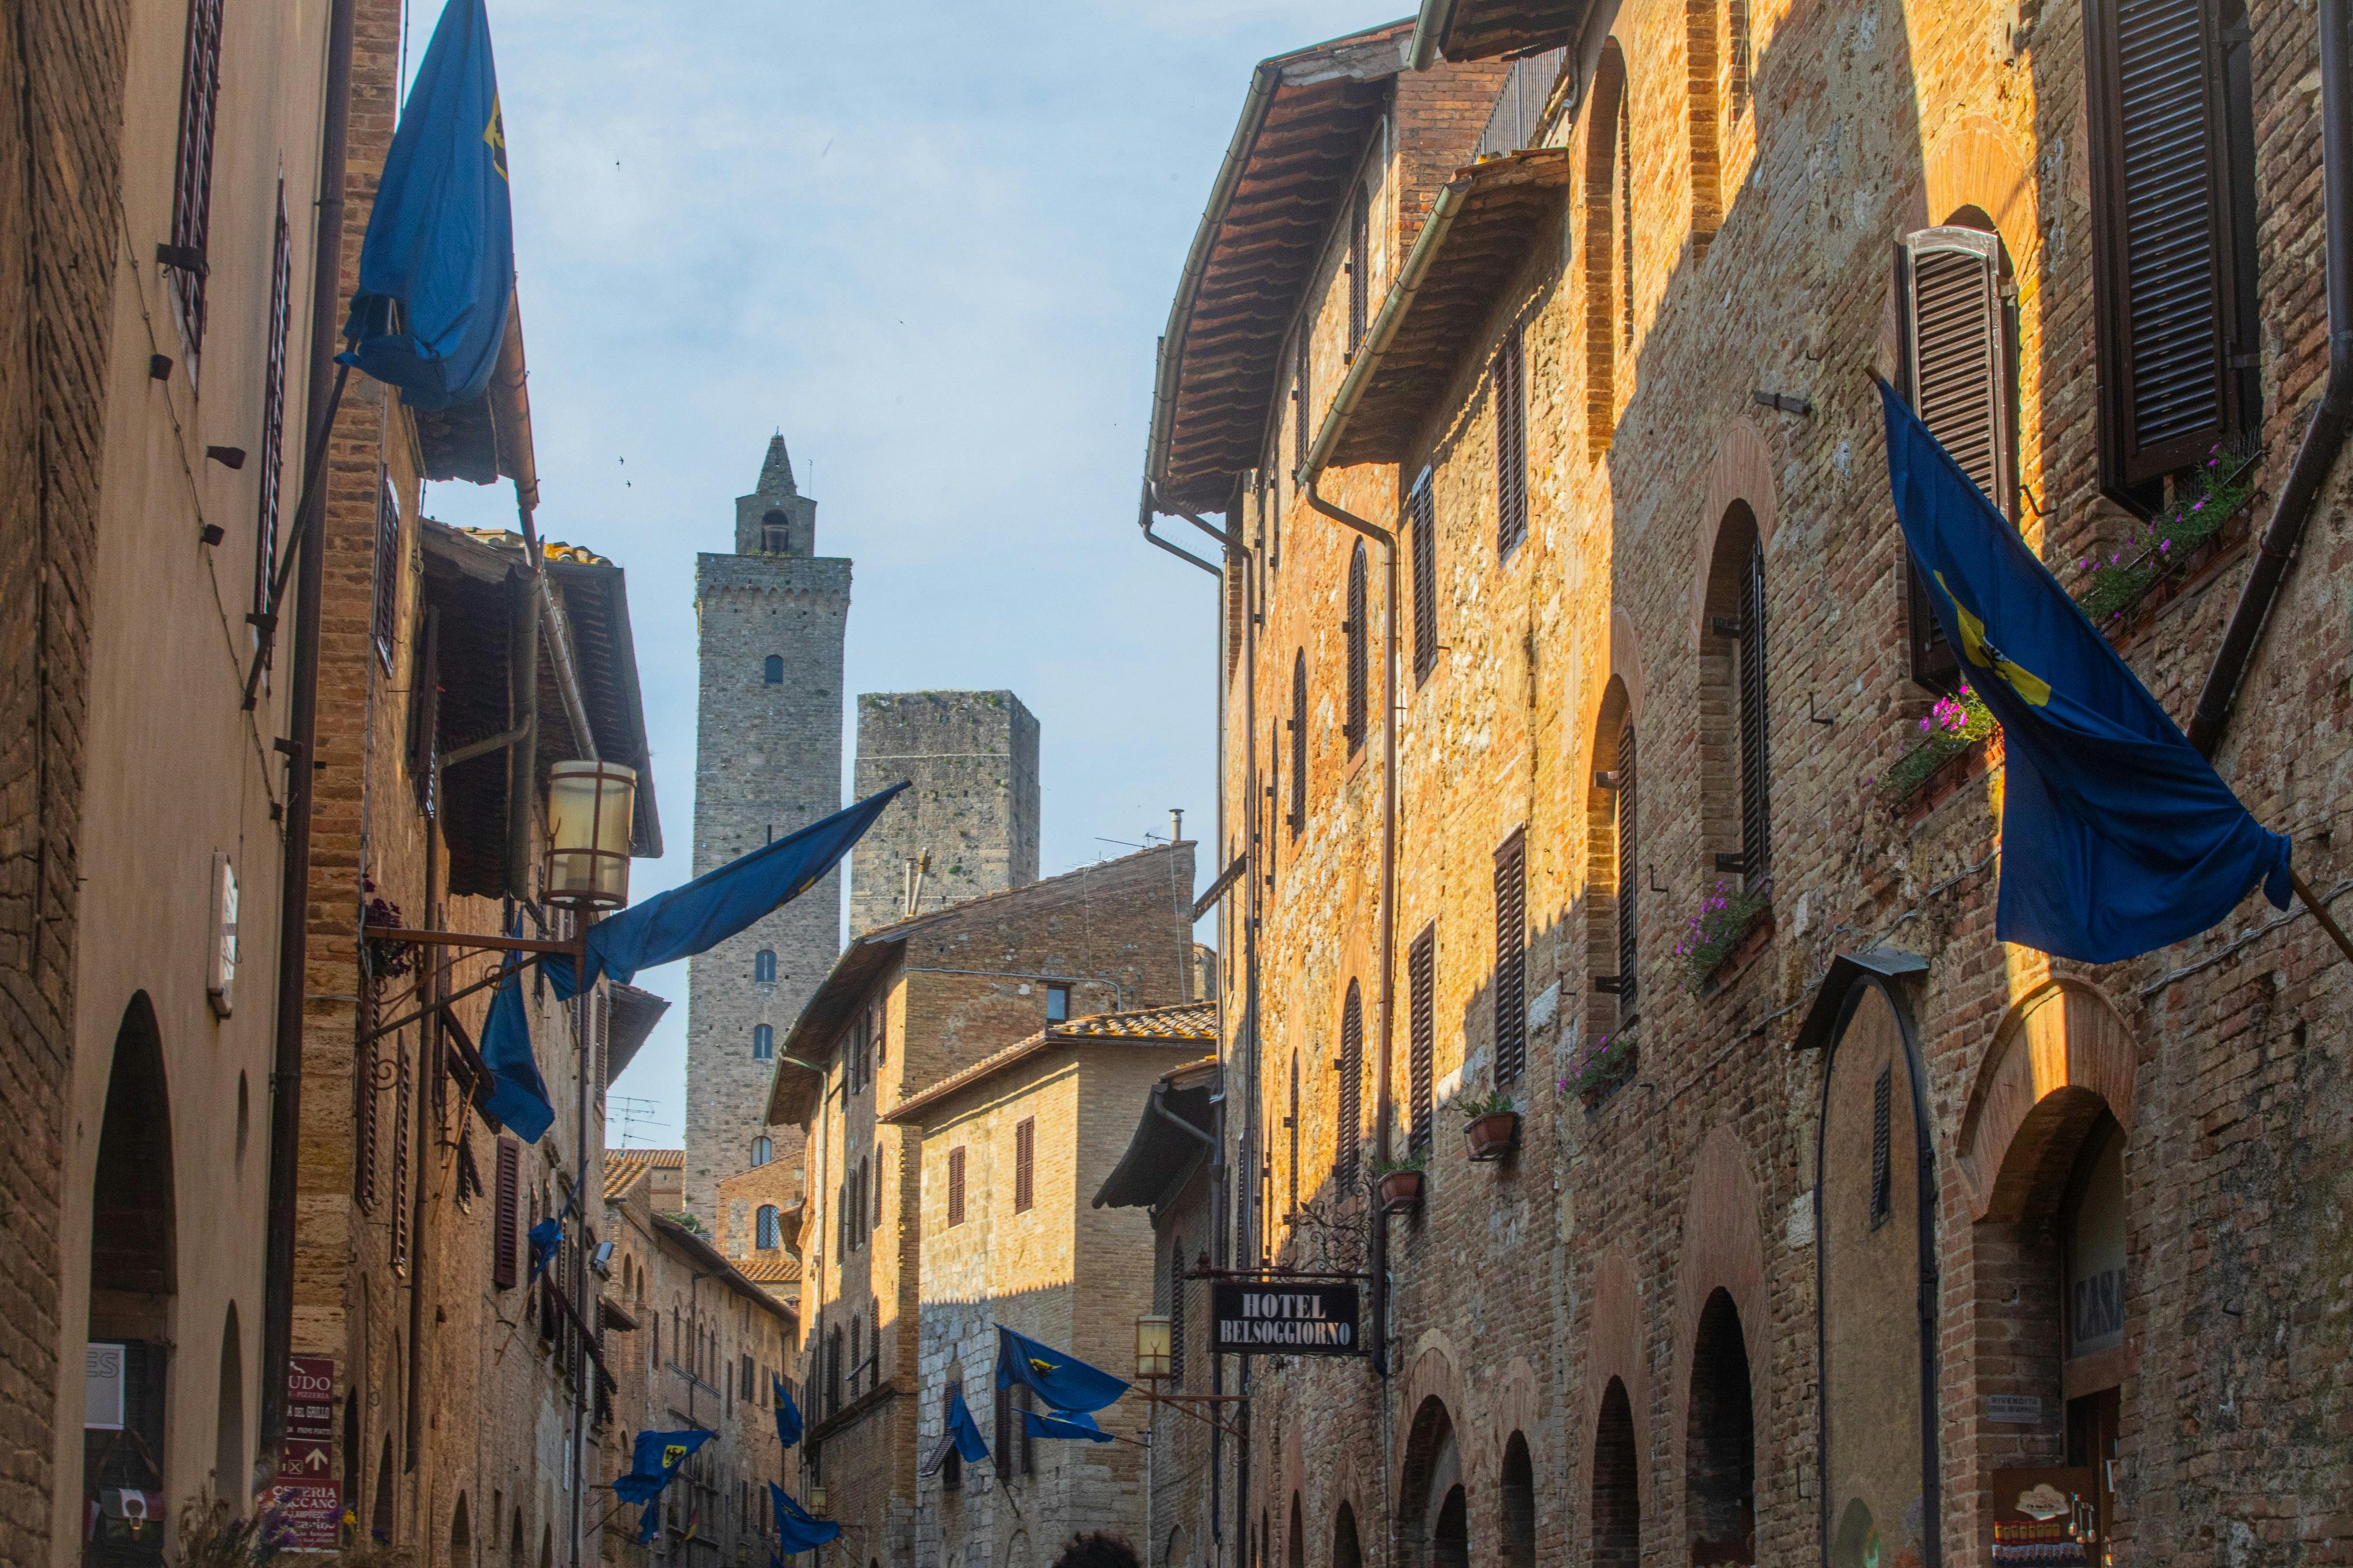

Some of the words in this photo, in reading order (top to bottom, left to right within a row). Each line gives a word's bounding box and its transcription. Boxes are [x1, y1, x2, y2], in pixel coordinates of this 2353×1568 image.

[1242, 1293, 1326, 1319] HOTEL
[1220, 1320, 1351, 1346] BELSOGGIORNO
[288, 1376, 331, 1391] UDO
[1991, 1397, 2038, 1405] RIVENDITA
[272, 1485, 337, 1499] OSERIA
